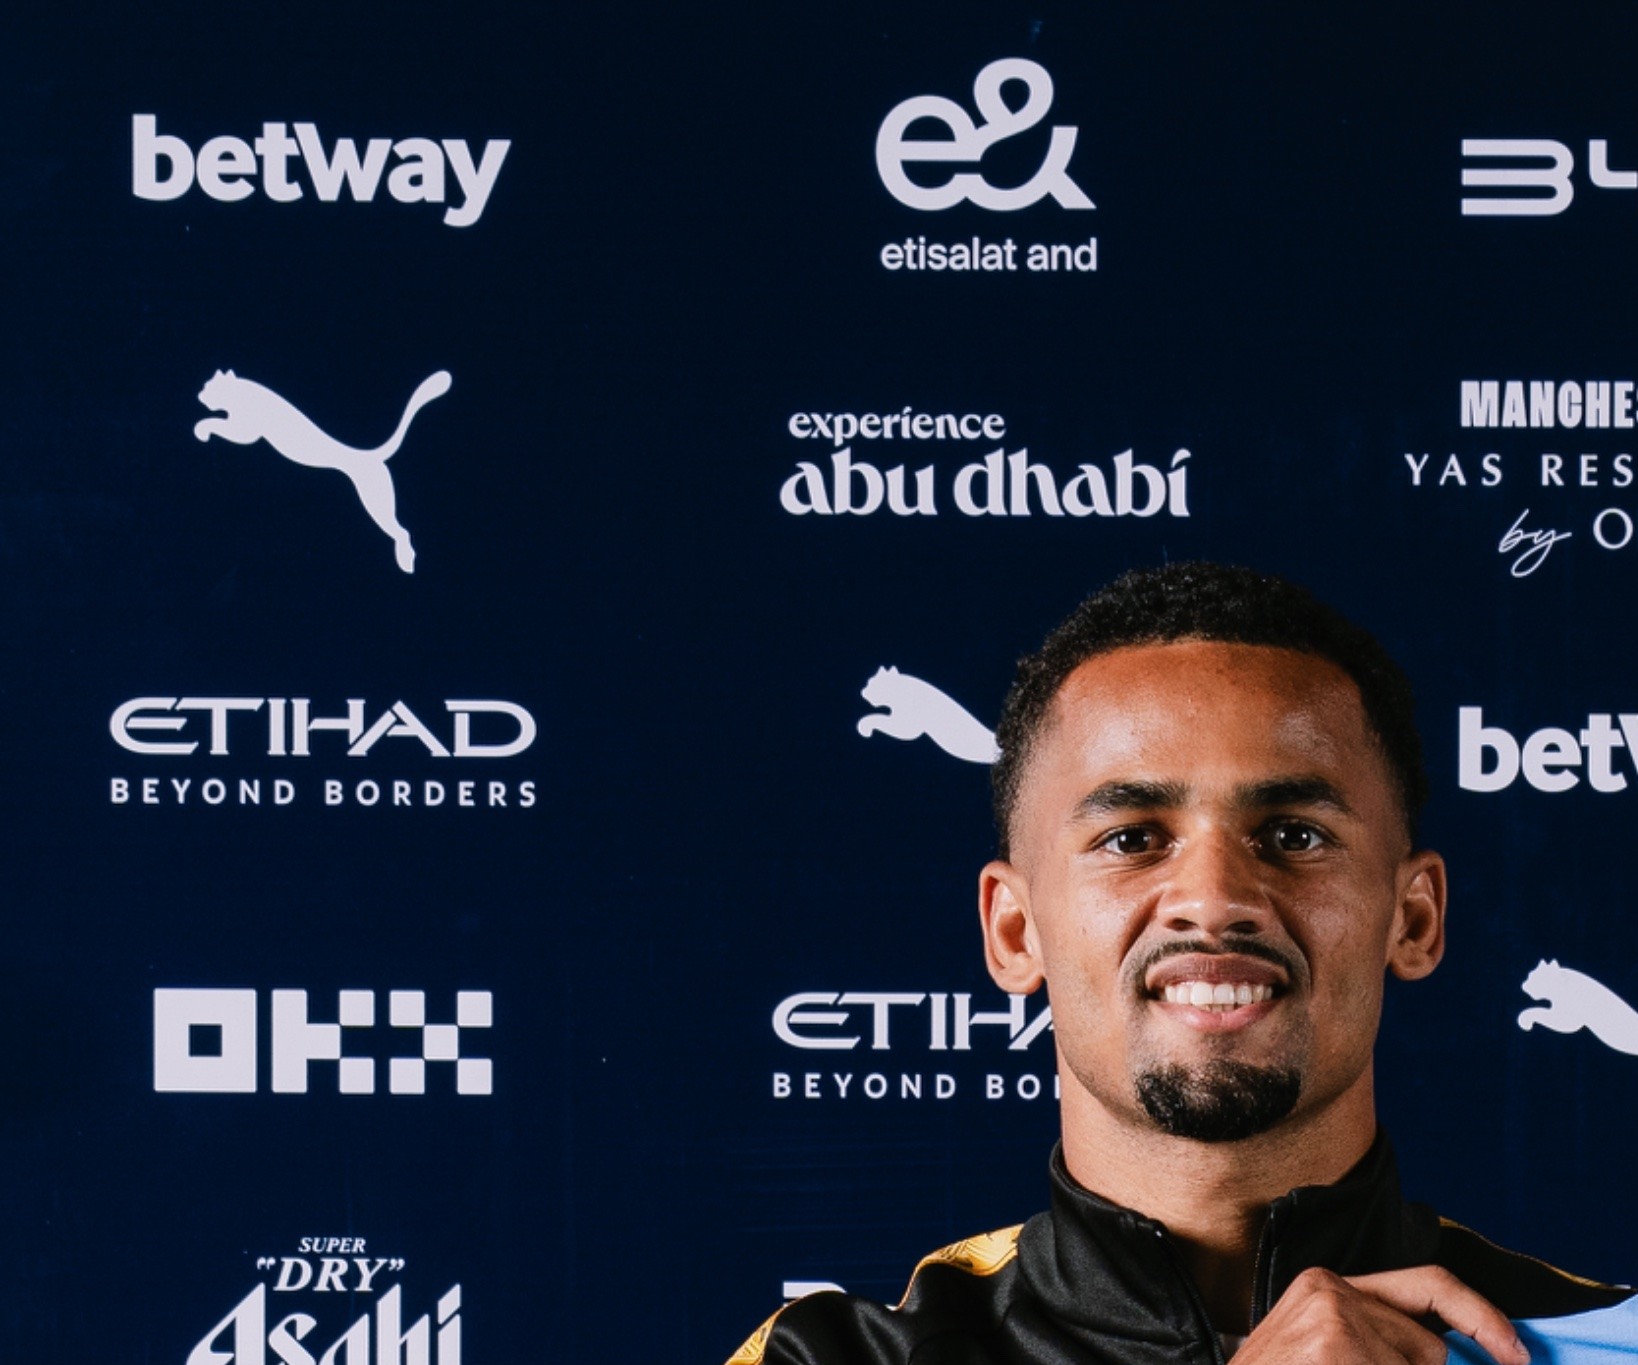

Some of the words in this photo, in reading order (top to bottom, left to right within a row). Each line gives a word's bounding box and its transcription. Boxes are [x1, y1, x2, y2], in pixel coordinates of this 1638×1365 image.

[132, 114, 511, 227] betway
[880, 236, 1017, 271] etisalat
[1027, 237, 1097, 271] and
[780, 447, 938, 516] abu
[1405, 453, 1502, 486] YAS
[1498, 509, 1572, 577] by
[109, 697, 537, 757] ETIHAD
[111, 778, 295, 805] BEYOND
[325, 780, 536, 807] BORDERS
[153, 988, 493, 1095] OKX
[772, 1073, 957, 1099] BEYOND
[298, 1237, 366, 1253] SUPER
